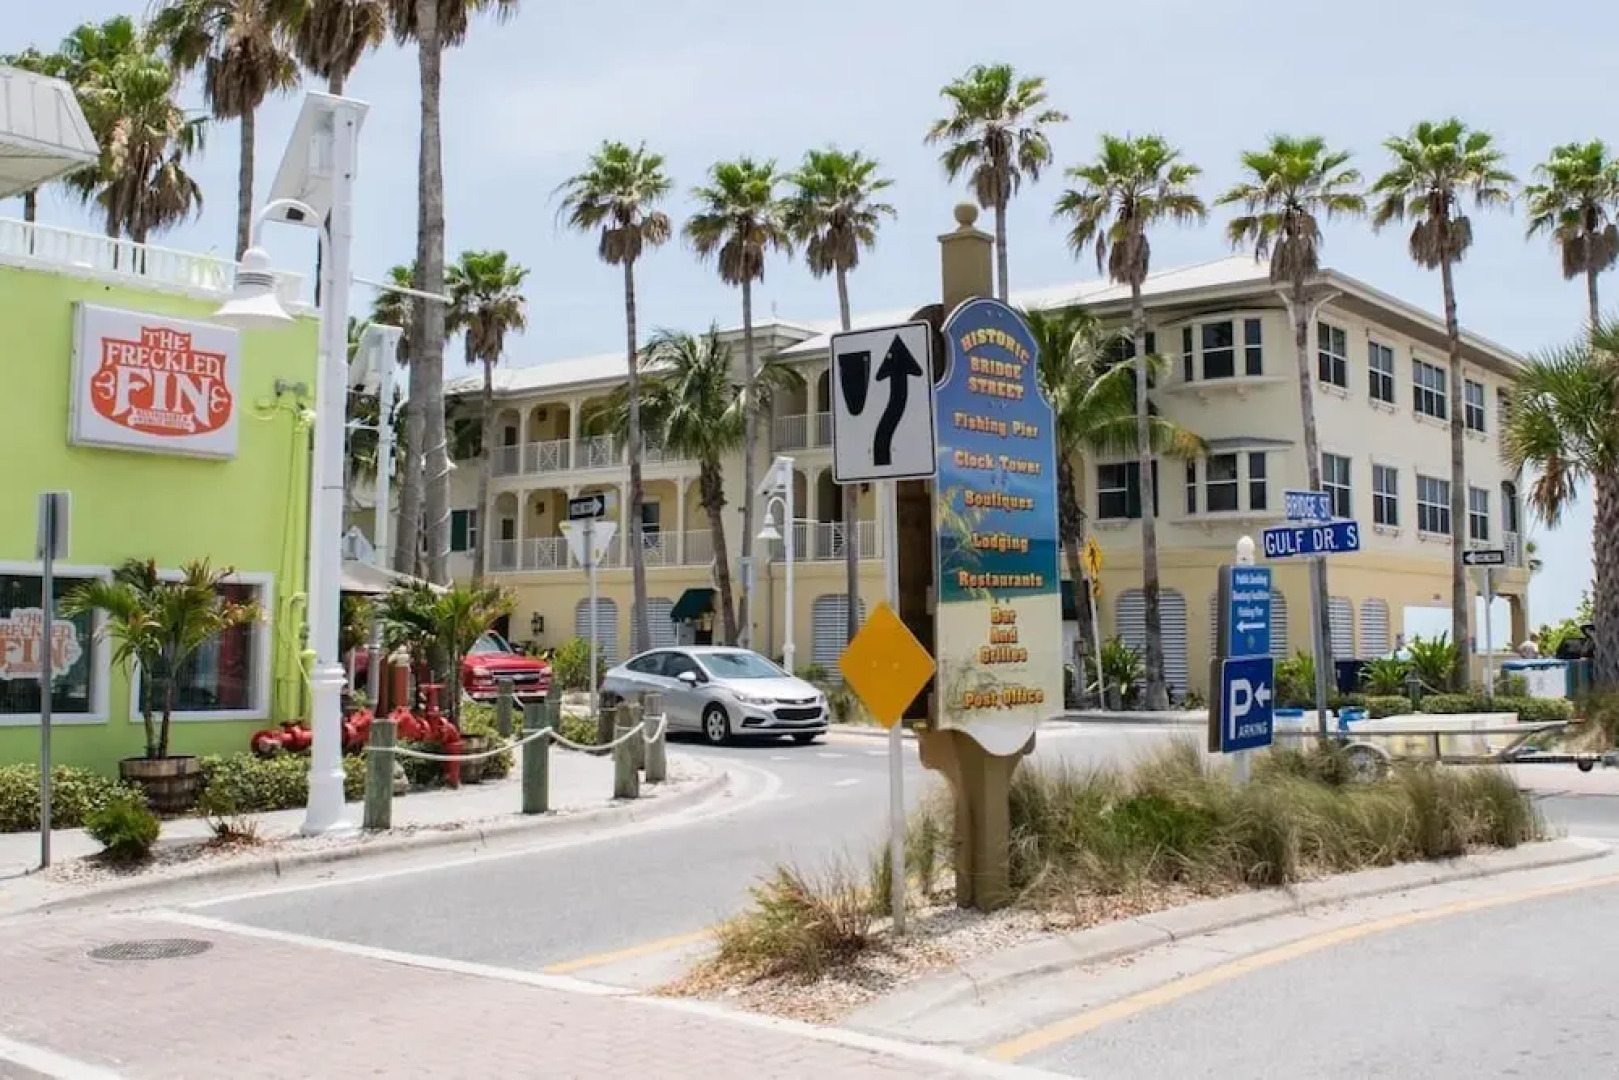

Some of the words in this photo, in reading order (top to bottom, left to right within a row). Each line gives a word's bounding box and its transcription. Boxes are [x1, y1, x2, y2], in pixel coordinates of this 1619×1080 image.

[143, 331, 190, 350] THE
[961, 328, 1030, 365] HISTORIC
[105, 342, 221, 382] FRECKLED
[970, 355, 1022, 380] BRIDGE
[112, 365, 212, 427] FIN
[968, 376, 1024, 400] STREET
[954, 411, 1007, 438] Fishing
[1012, 420, 1038, 438] Pier
[954, 450, 994, 470] Clock
[999, 454, 1041, 474] Tower
[964, 489, 1035, 512] Boutiques
[1286, 494, 1317, 518] BRIDGE
[972, 532, 1028, 553] Lodging
[1265, 529, 1304, 555] GULF
[1312, 527, 1340, 550] DR.
[1346, 525, 1358, 548] S
[958, 569, 1043, 588] Restaurants
[990, 607, 1016, 624] Bar
[989, 626, 1017, 644] And
[964, 689, 998, 708] Post
[1002, 686, 1043, 705] Office
